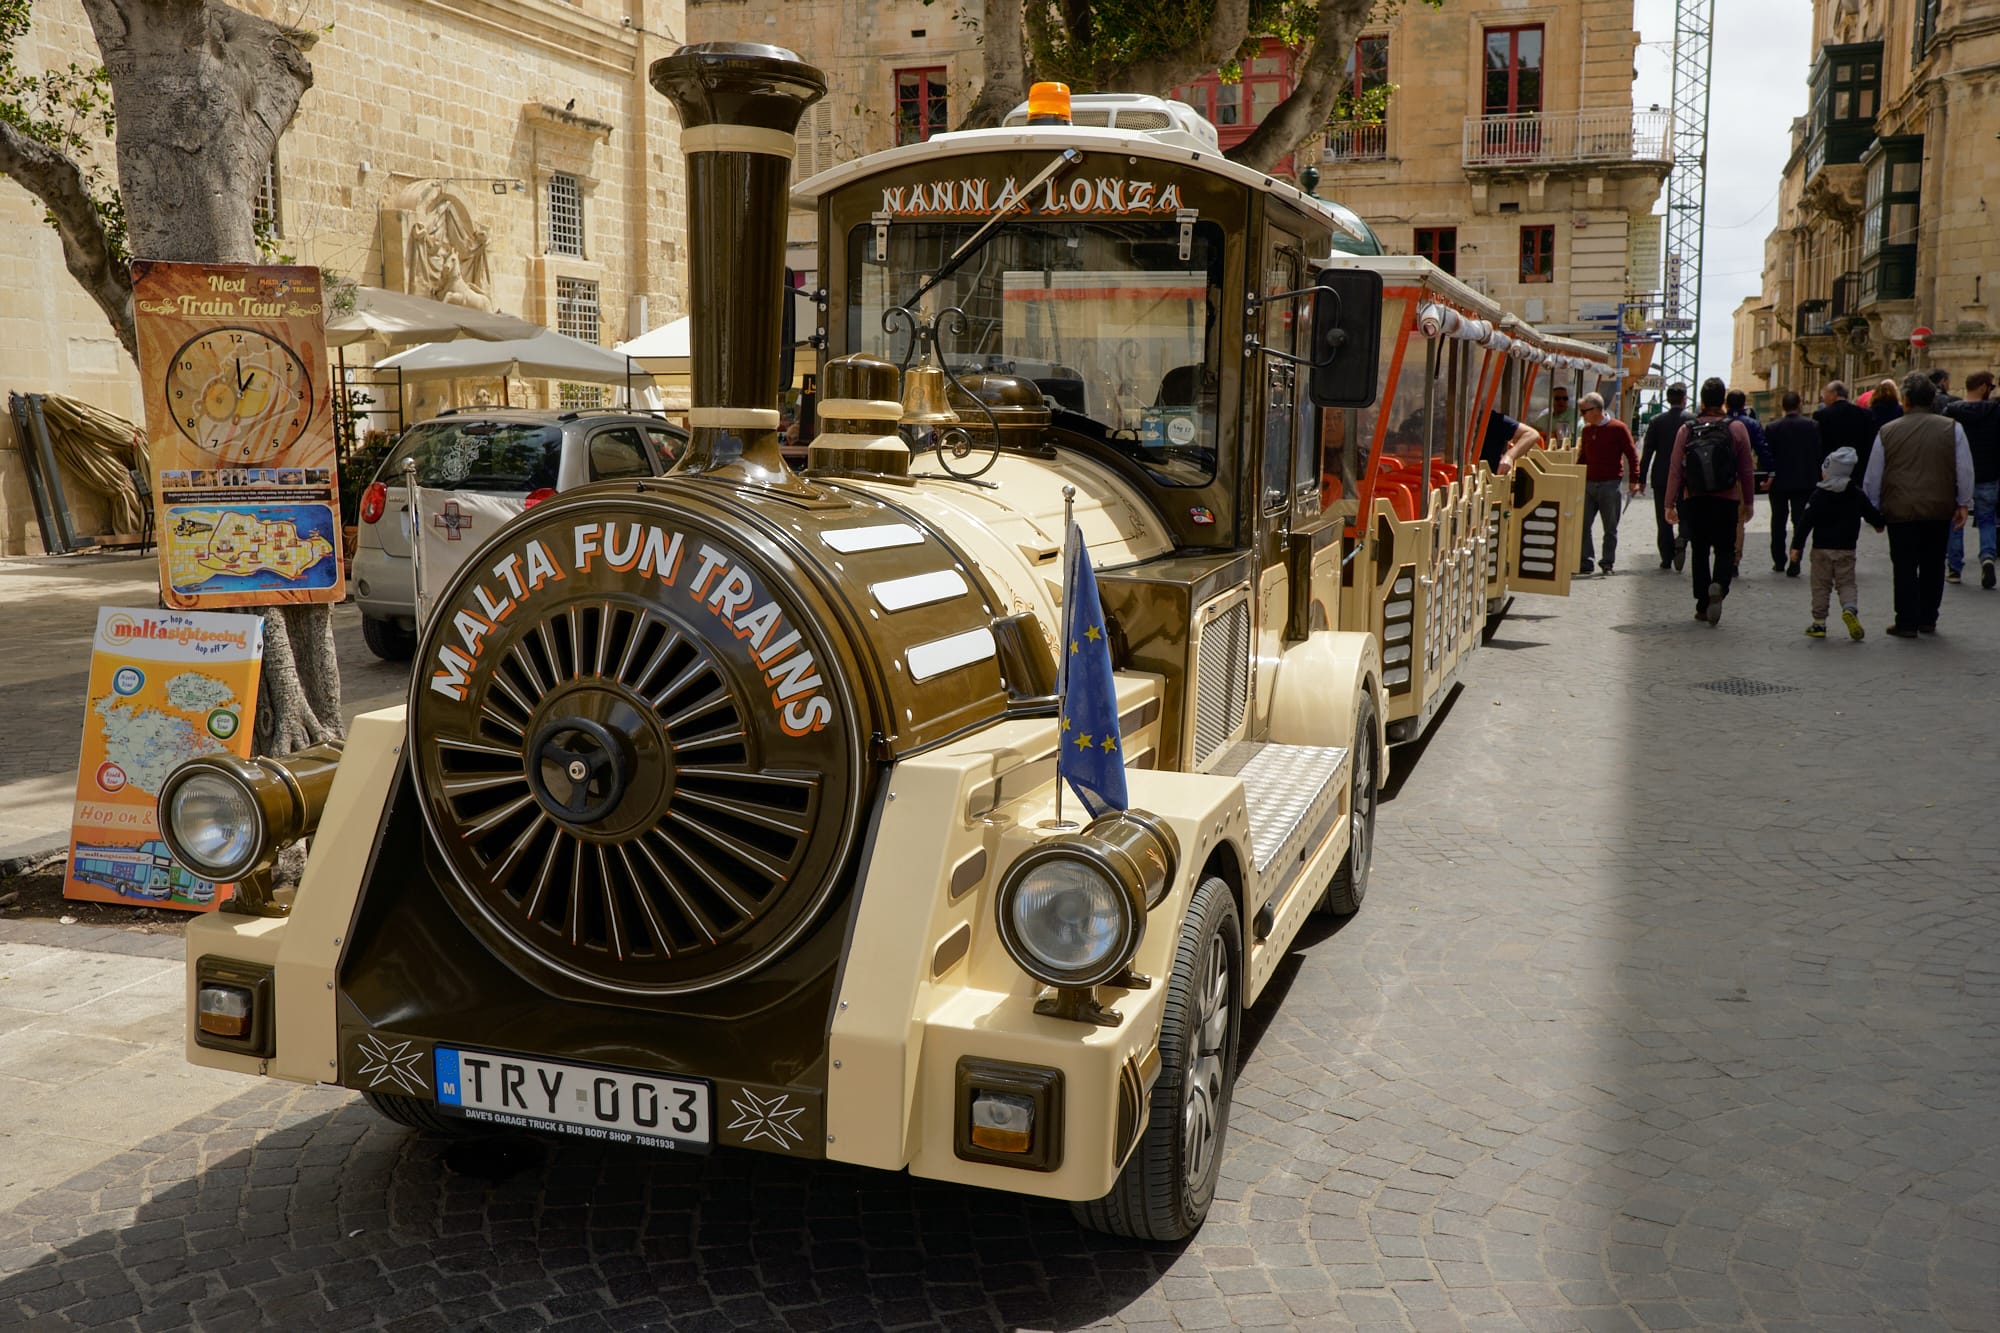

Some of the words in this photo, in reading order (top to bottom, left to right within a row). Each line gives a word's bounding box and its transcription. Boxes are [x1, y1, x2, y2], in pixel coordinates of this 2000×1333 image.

[882, 175, 1030, 216] NANNA
[1040, 176, 1184, 216] LONZA
[208, 275, 246, 293] Next
[1670, 258, 1680, 315] OLYMPUS
[177, 295, 235, 316] Train
[238, 297, 287, 317] Tour
[229, 334, 243, 343] 12
[201, 341, 212, 349] 11
[265, 342, 270, 350] 1
[179, 361, 193, 371] 10
[286, 363, 294, 372] 2
[176, 390, 183, 399] 9
[298, 391, 304, 399] 3
[187, 418, 195, 428] 8
[291, 418, 299, 427] 4
[211, 439, 219, 448] 7
[272, 439, 279, 447] 5
[243, 447, 250, 455] 6
[170, 615, 183, 625] hop
[184, 618, 193, 626] on
[430, 538, 566, 702] MALTA
[574, 521, 685, 587] FUN
[689, 543, 832, 738] TRAINS
[195, 642, 208, 655] hop
[210, 643, 220, 654] off
[80, 805, 113, 825] Hop
[119, 814, 137, 824] on
[142, 811, 152, 825] &
[443, 1082, 456, 1095] M
[464, 1058, 564, 1114] TRY
[593, 1077, 697, 1134] 003
[465, 1109, 493, 1122] DAVE'S
[494, 1113, 527, 1127] GARAGE
[528, 1119, 557, 1132] TRUCK
[558, 1123, 565, 1133] &
[566, 1124, 584, 1136] BUS
[584, 1127, 608, 1139] BODY
[609, 1131, 632, 1143] SHOP
[635, 1135, 675, 1150] 79881938
